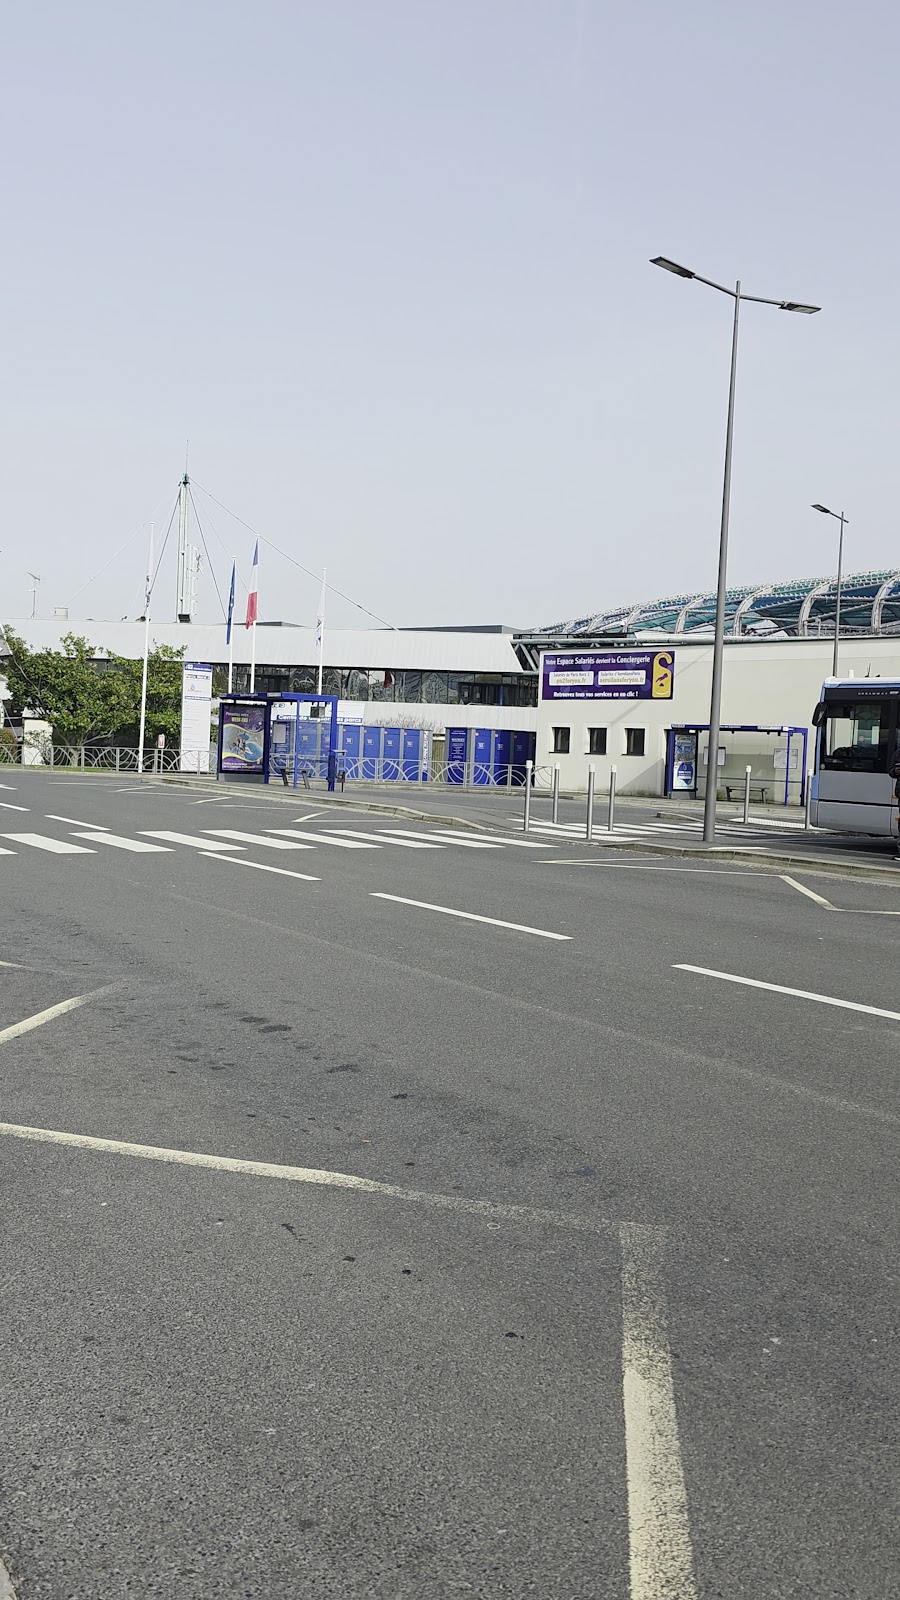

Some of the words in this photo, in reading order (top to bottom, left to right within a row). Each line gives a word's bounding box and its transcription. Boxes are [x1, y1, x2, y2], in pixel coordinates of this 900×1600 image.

[557, 657, 574, 666] Espace
[575, 656, 595, 665] Salariés
[616, 655, 650, 664] Conciergerie
